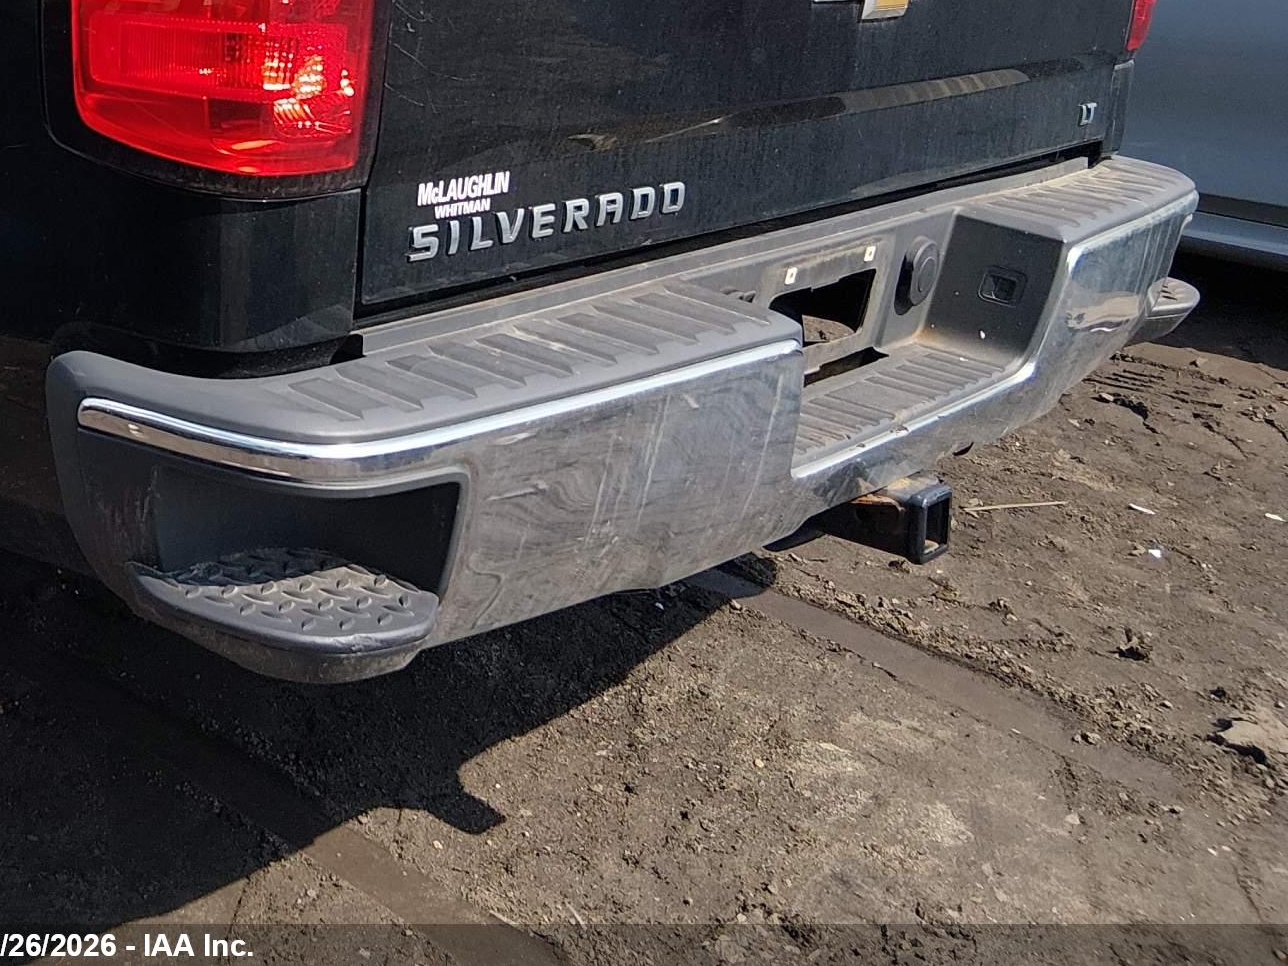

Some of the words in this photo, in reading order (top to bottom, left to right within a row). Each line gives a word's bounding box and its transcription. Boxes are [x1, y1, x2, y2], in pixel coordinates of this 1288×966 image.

[1079, 102, 1097, 125] LT
[417, 171, 510, 206] McLAUGHLIN
[407, 181, 686, 262] SILVERADO
[434, 198, 491, 219] WHITMAN
